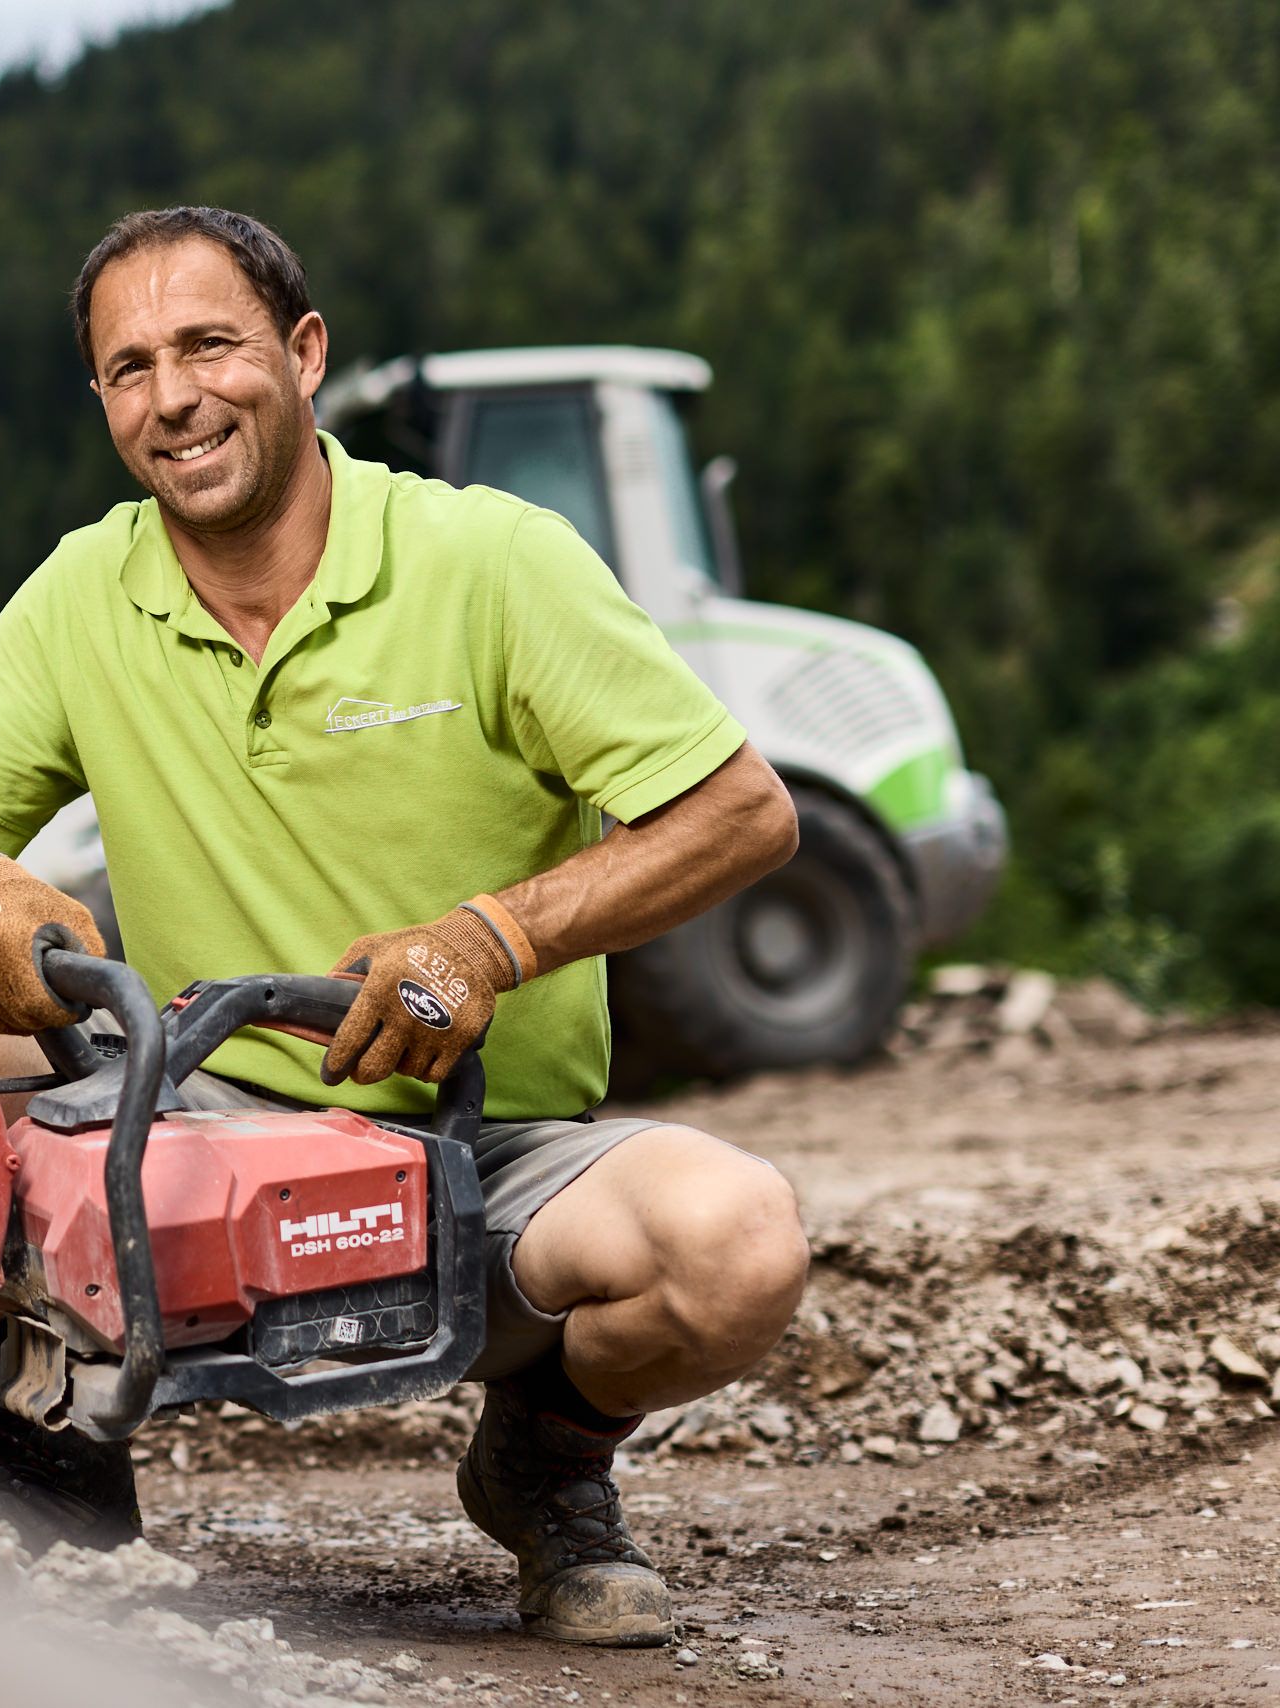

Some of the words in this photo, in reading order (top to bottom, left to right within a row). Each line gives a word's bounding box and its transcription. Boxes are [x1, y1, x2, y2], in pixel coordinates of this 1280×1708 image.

[334, 709, 385, 729] ECKERT
[280, 1202, 403, 1242] HILTI
[291, 1239, 331, 1257] DSH
[336, 1228, 404, 1250] 600-22
